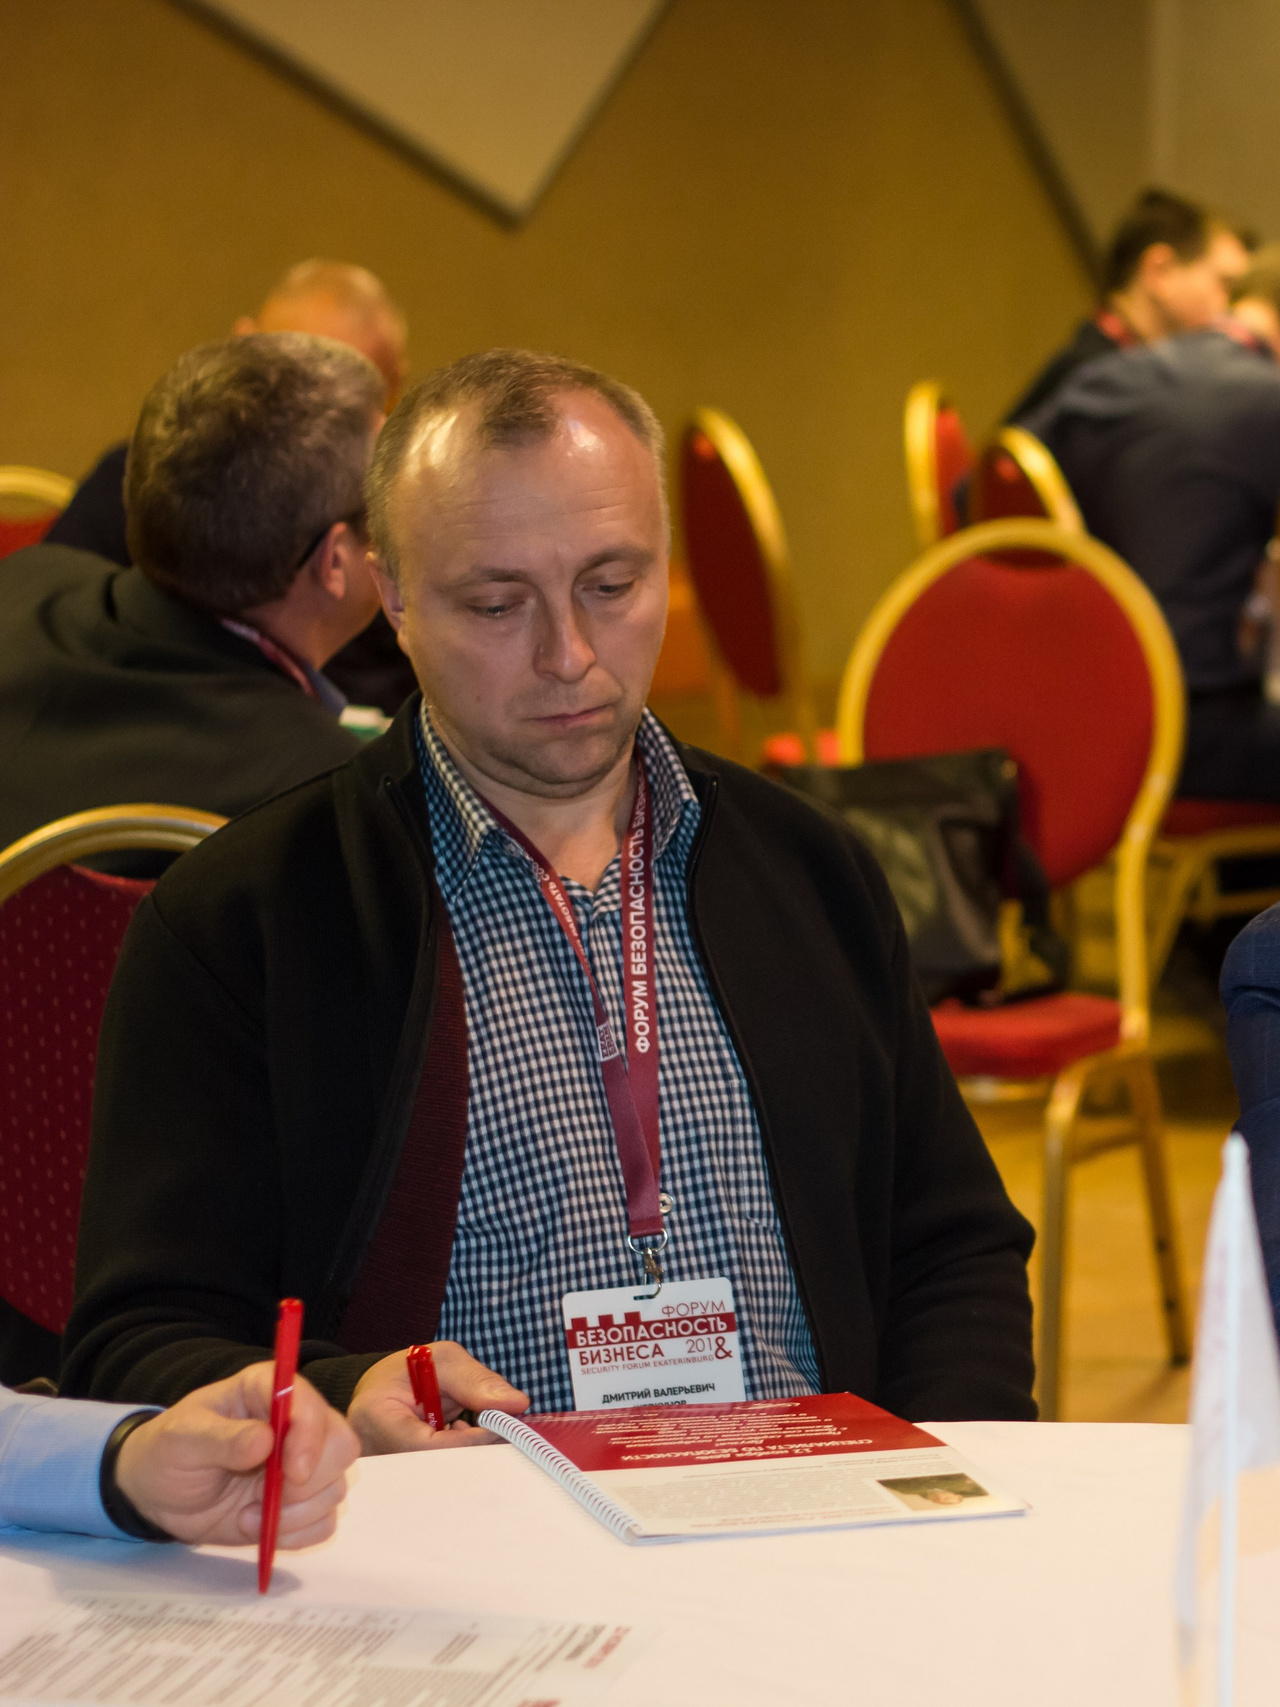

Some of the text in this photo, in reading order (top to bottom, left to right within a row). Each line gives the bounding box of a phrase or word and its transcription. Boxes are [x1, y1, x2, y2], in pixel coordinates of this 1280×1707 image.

[628, 828, 648, 975] БЕЗОПАСНОСТЬ
[631, 980, 651, 1053] ФОРУМ
[662, 1300, 726, 1317] ФОРУМ
[576, 1317, 727, 1346] БЕЗОПАСНОСТЬ
[579, 1343, 664, 1365] БИЗНЕСА
[581, 1355, 714, 1375] SECURITY FORUM EKATERINBURG
[602, 1388, 651, 1404] ДМИТРИЙ
[654, 1383, 715, 1397] ВАЛЕРЬЕВИЧ
